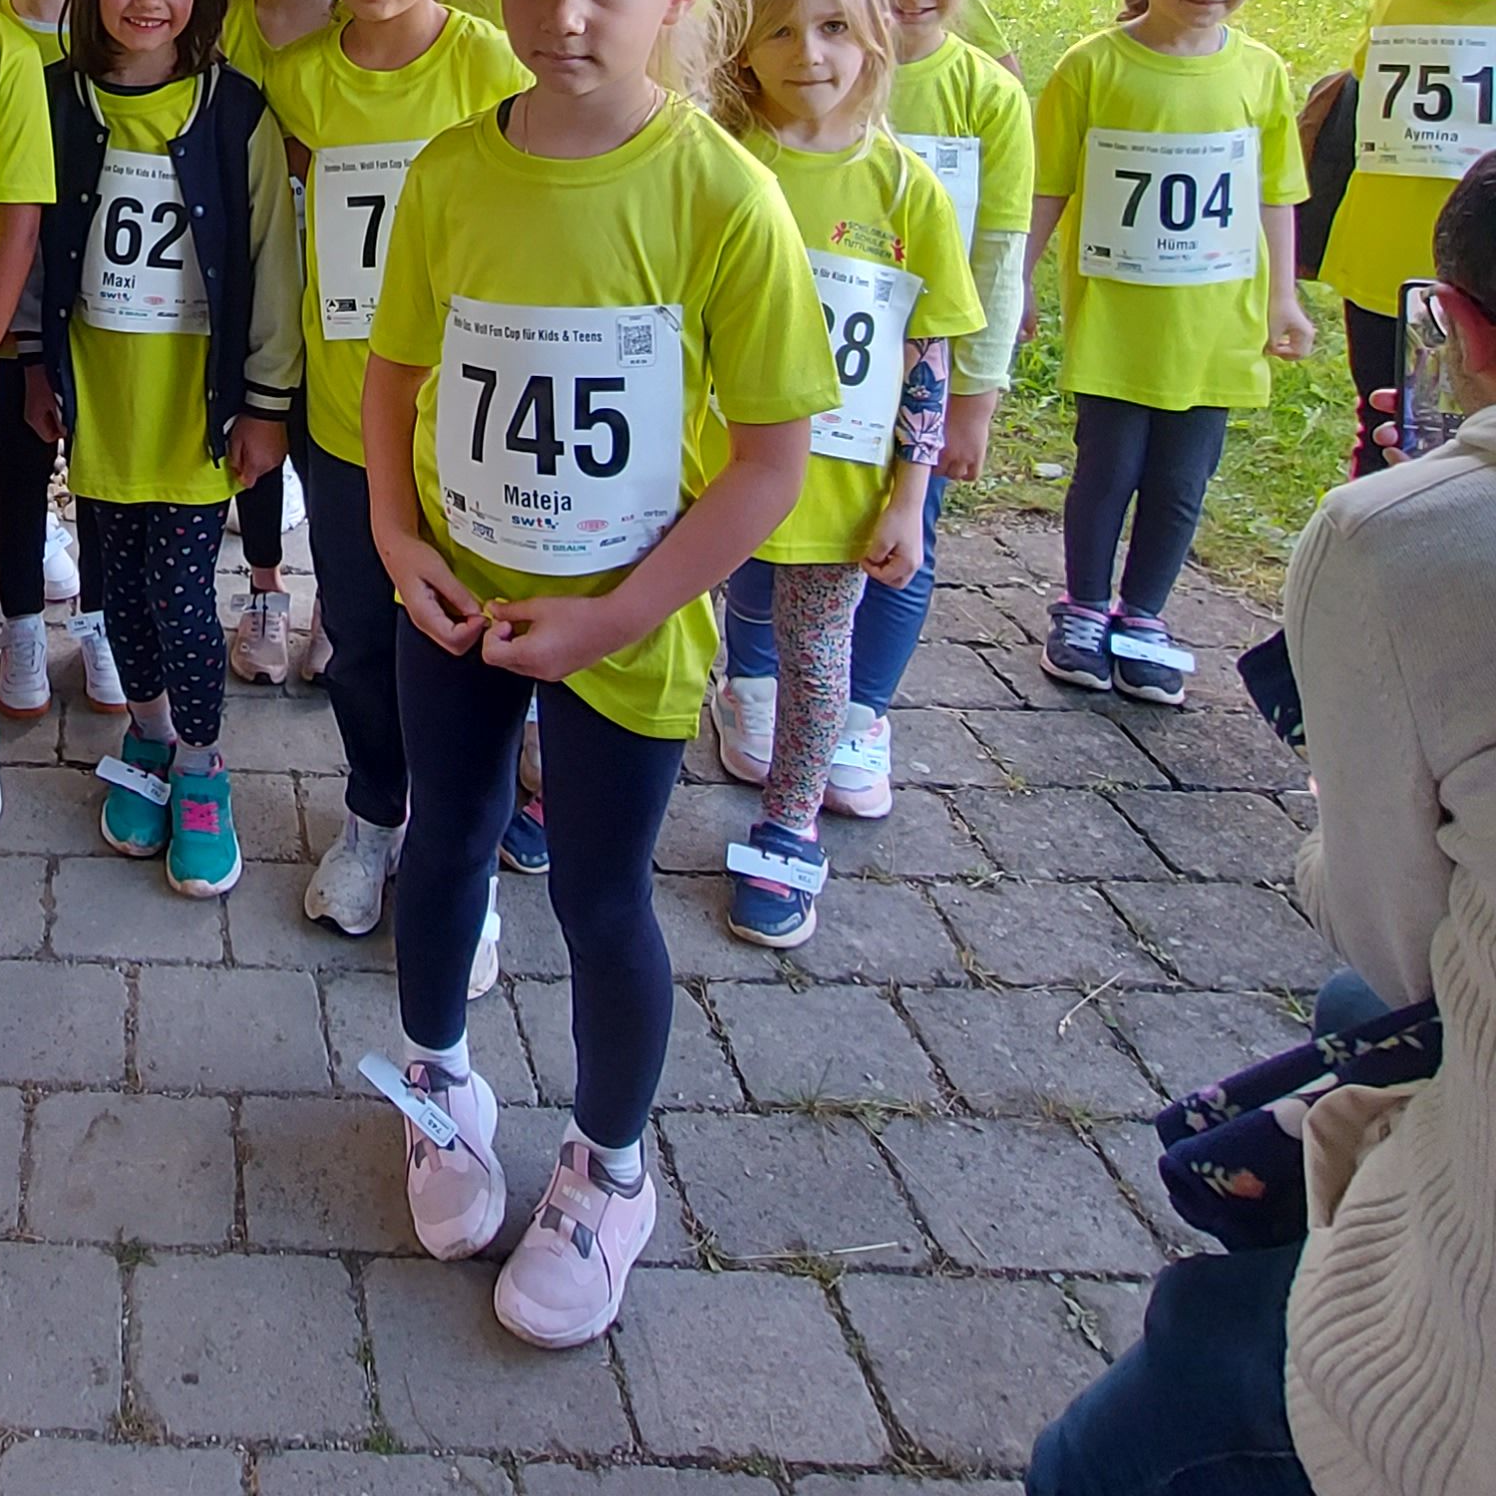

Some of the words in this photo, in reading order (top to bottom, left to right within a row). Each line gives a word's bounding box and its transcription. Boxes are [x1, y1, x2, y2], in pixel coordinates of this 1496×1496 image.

[1378, 64, 1493, 125] 751
[1404, 127, 1459, 142] Aymina
[1115, 169, 1233, 231] 704
[101, 195, 188, 270] 62
[347, 195, 387, 267] 7
[1157, 238, 1197, 251] Hüma
[103, 272, 135, 288] Maxi
[504, 326, 520, 341] Cup
[522, 328, 535, 341] für
[538, 329, 559, 342] Kids
[562, 330, 570, 342] &
[572, 330, 602, 343] Teens
[462, 363, 630, 478] 745
[504, 484, 571, 515] Mateja
